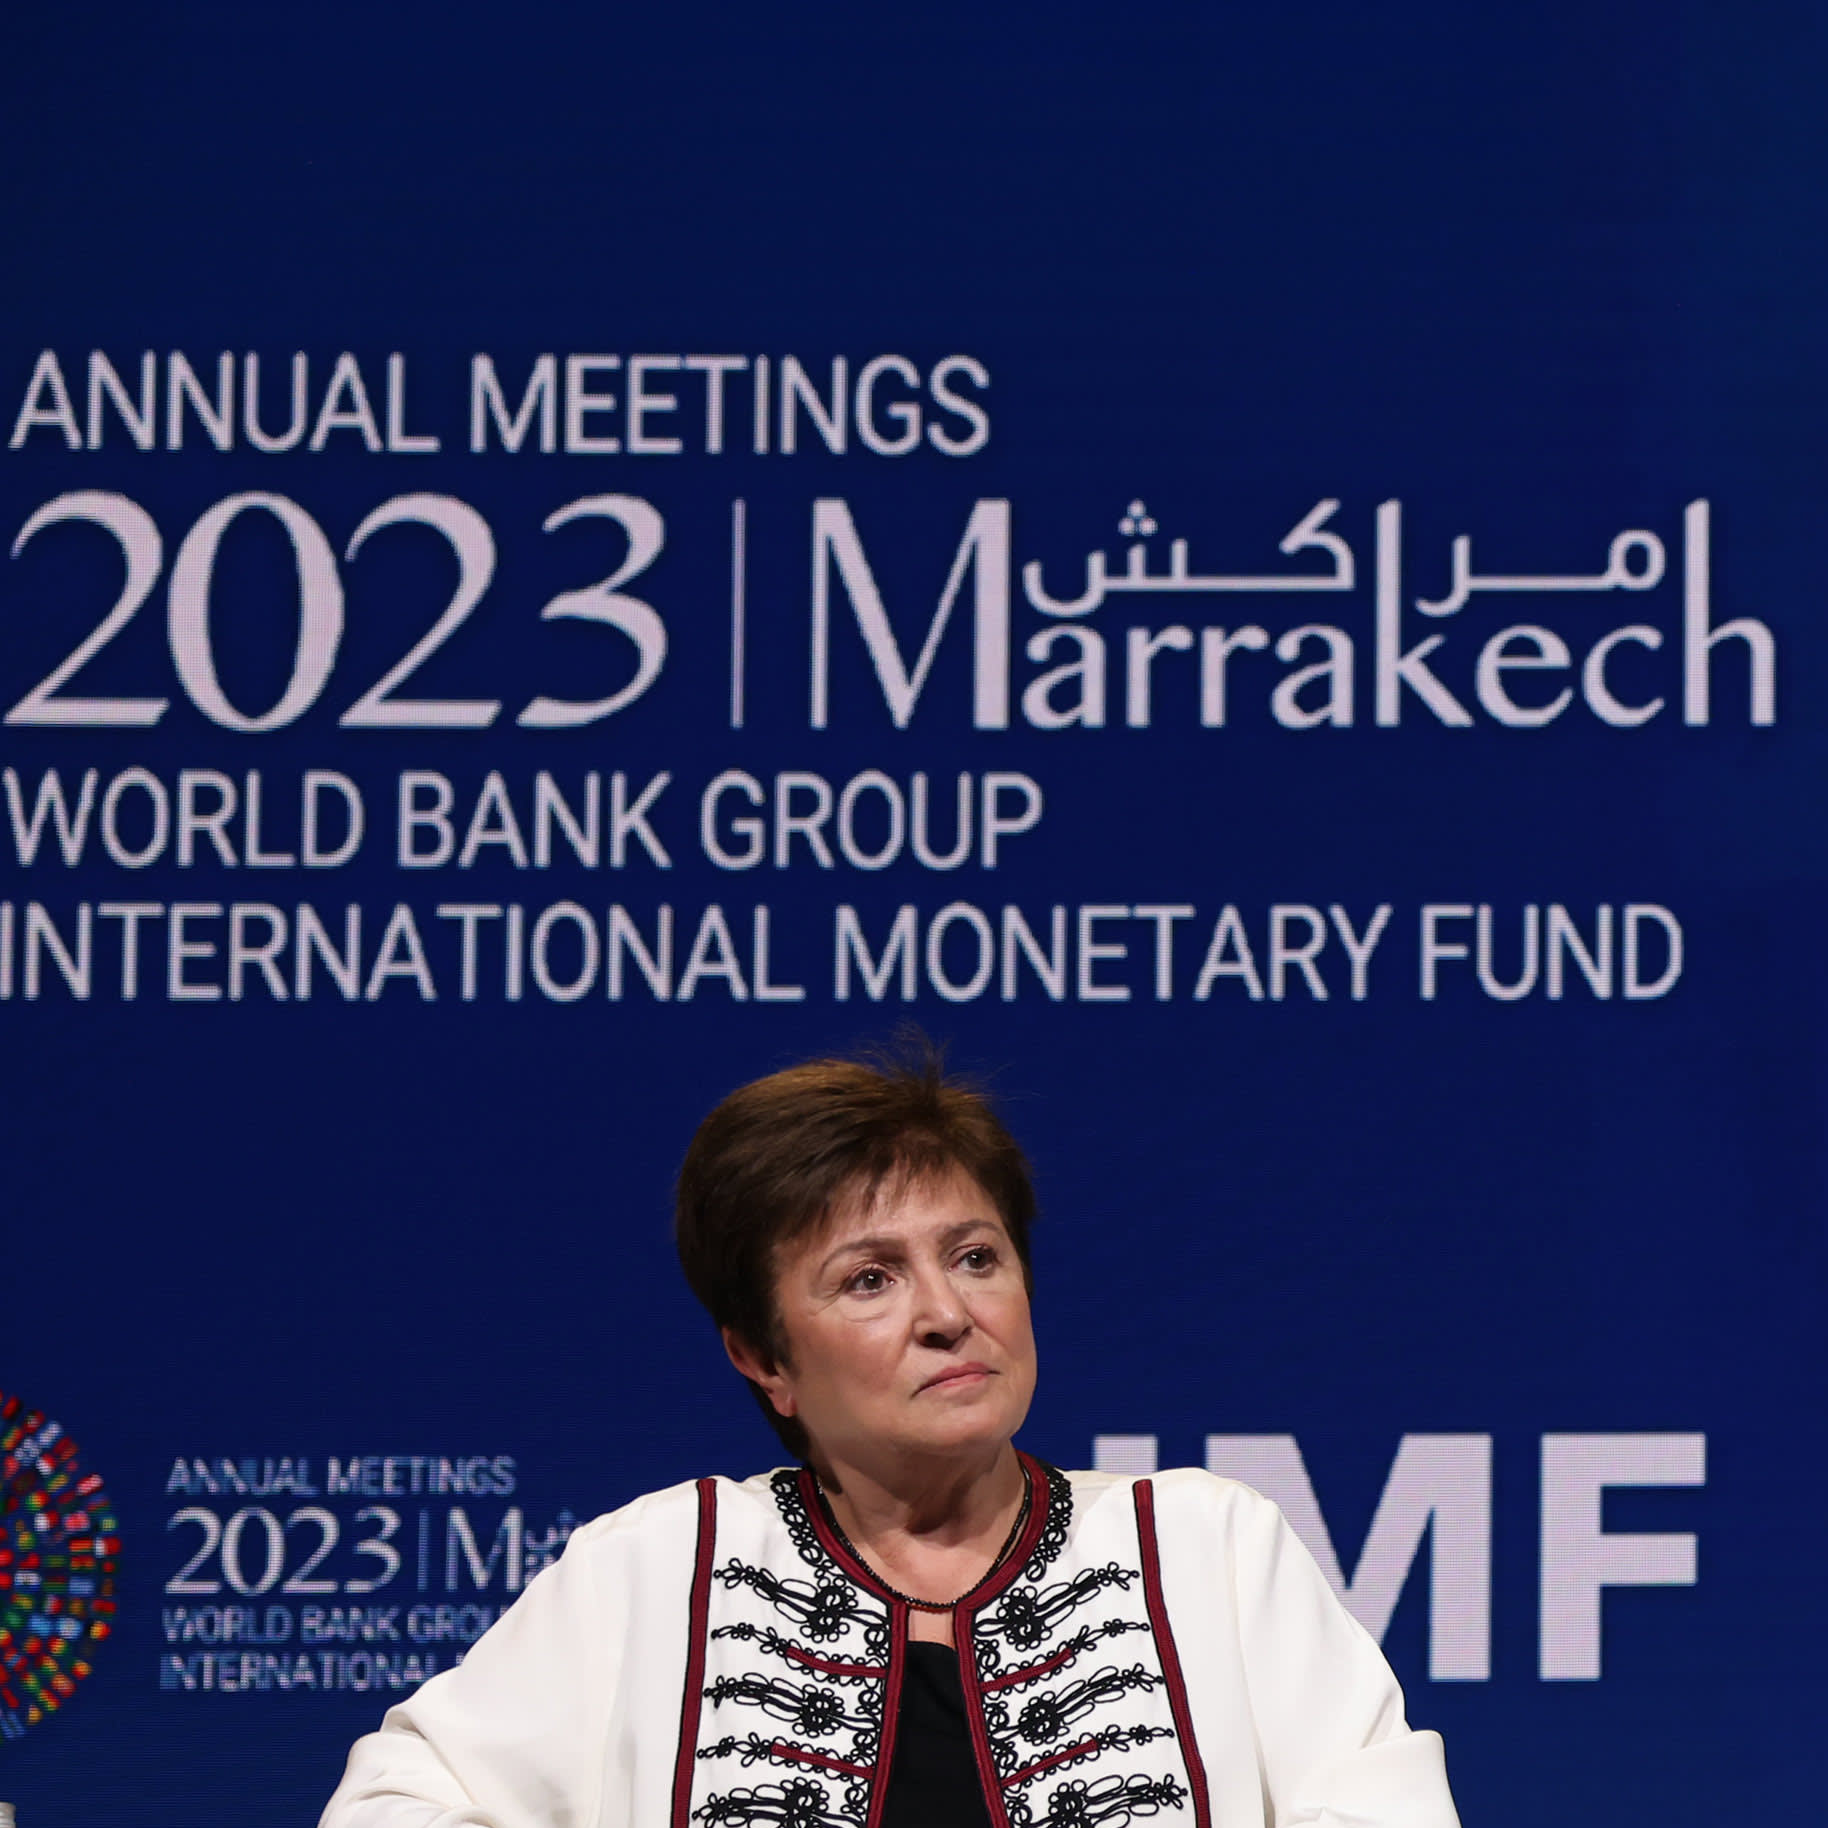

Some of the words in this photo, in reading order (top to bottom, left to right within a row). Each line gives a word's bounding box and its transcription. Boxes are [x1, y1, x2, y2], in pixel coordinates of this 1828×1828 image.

[7, 349, 441, 453] ANNUAL
[470, 352, 990, 456] MEETINGS
[2, 489, 669, 732] 2023
[810, 497, 1777, 731] Marrakech
[2, 766, 364, 869] WORLD
[397, 770, 672, 868] BANK
[700, 770, 1043, 871] GROUP
[0, 901, 806, 1003] INTERNATIONAL
[834, 901, 1393, 1003] MONETARY
[1419, 903, 1684, 1001] FUND
[165, 1456, 320, 1496] ANNUAL
[327, 1455, 518, 1496] MEETINGS
[165, 1506, 401, 1595] 2023
[1093, 1432, 1706, 1681] MF
[161, 1606, 295, 1643] WORLD
[302, 1606, 399, 1643] BANK
[407, 1605, 509, 1643] GRO
